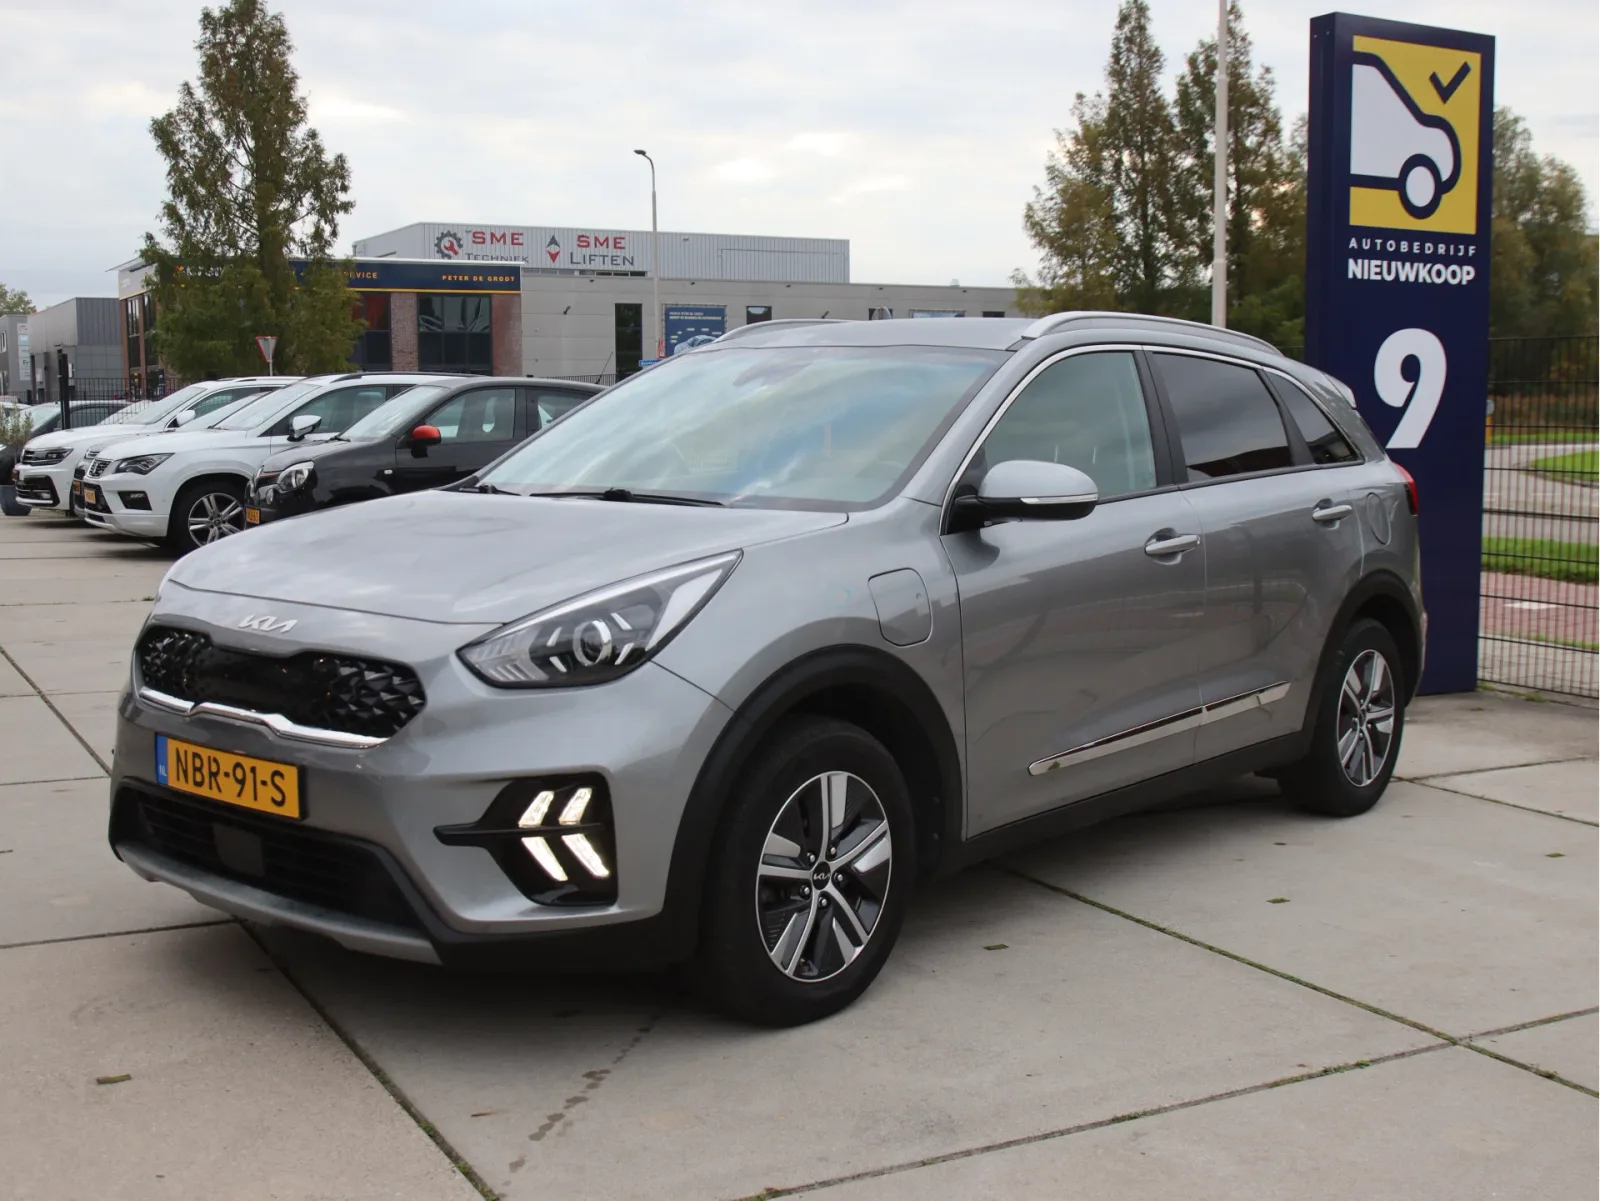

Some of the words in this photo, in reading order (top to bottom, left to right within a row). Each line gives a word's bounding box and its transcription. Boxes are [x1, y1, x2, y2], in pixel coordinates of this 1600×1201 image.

[472, 231, 524, 246] SME
[577, 234, 626, 249] SME
[1348, 237, 1477, 257] AUTOBEDRIJF
[570, 251, 634, 266] LIFTEN
[1347, 258, 1476, 286] NIEUWKOOP
[1374, 327, 1447, 450] 9
[175, 746, 287, 807] NBR-91-S
